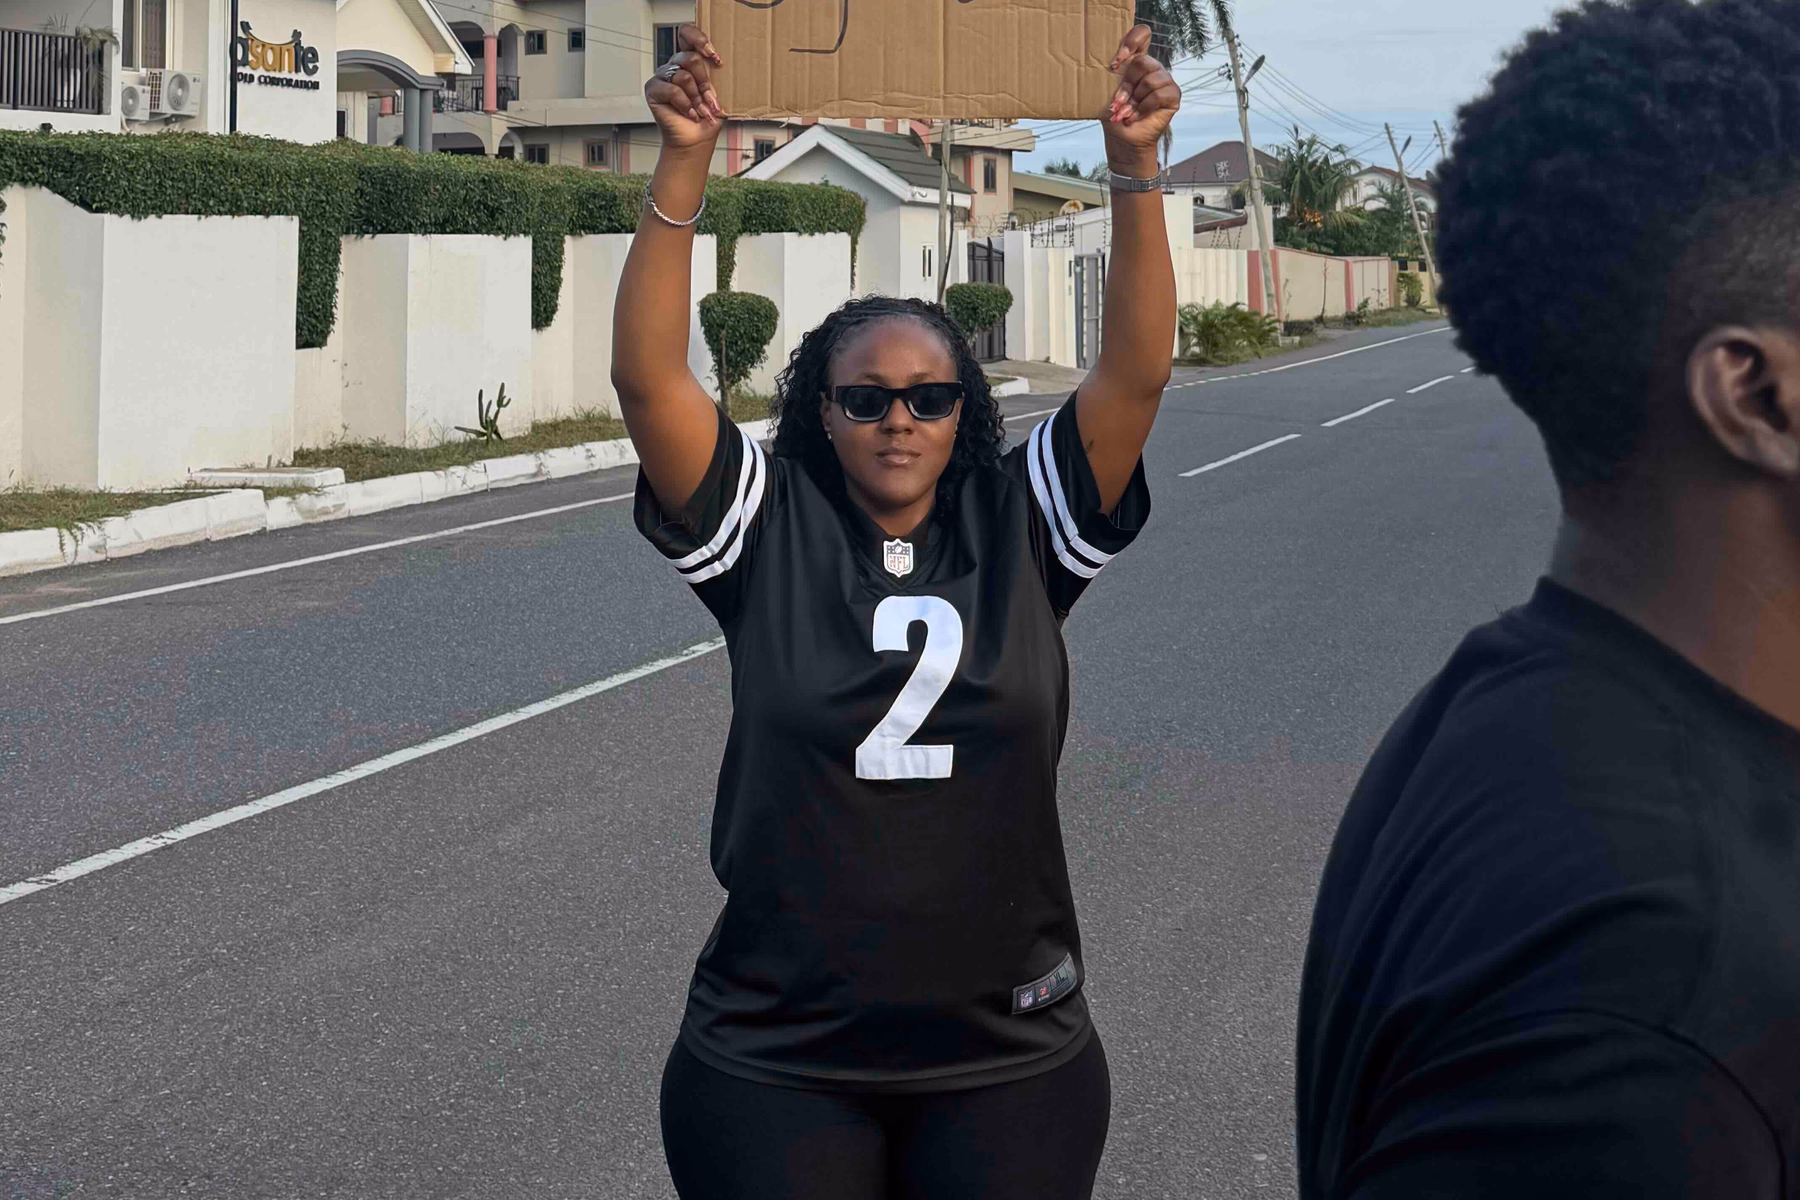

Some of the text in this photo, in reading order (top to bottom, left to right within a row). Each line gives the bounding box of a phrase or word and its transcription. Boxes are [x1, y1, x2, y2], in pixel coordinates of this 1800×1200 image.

[229, 31, 319, 76] asante
[231, 71, 320, 90] OLD CORPORATION
[889, 554, 910, 570] NFL
[856, 595, 963, 780] 2
